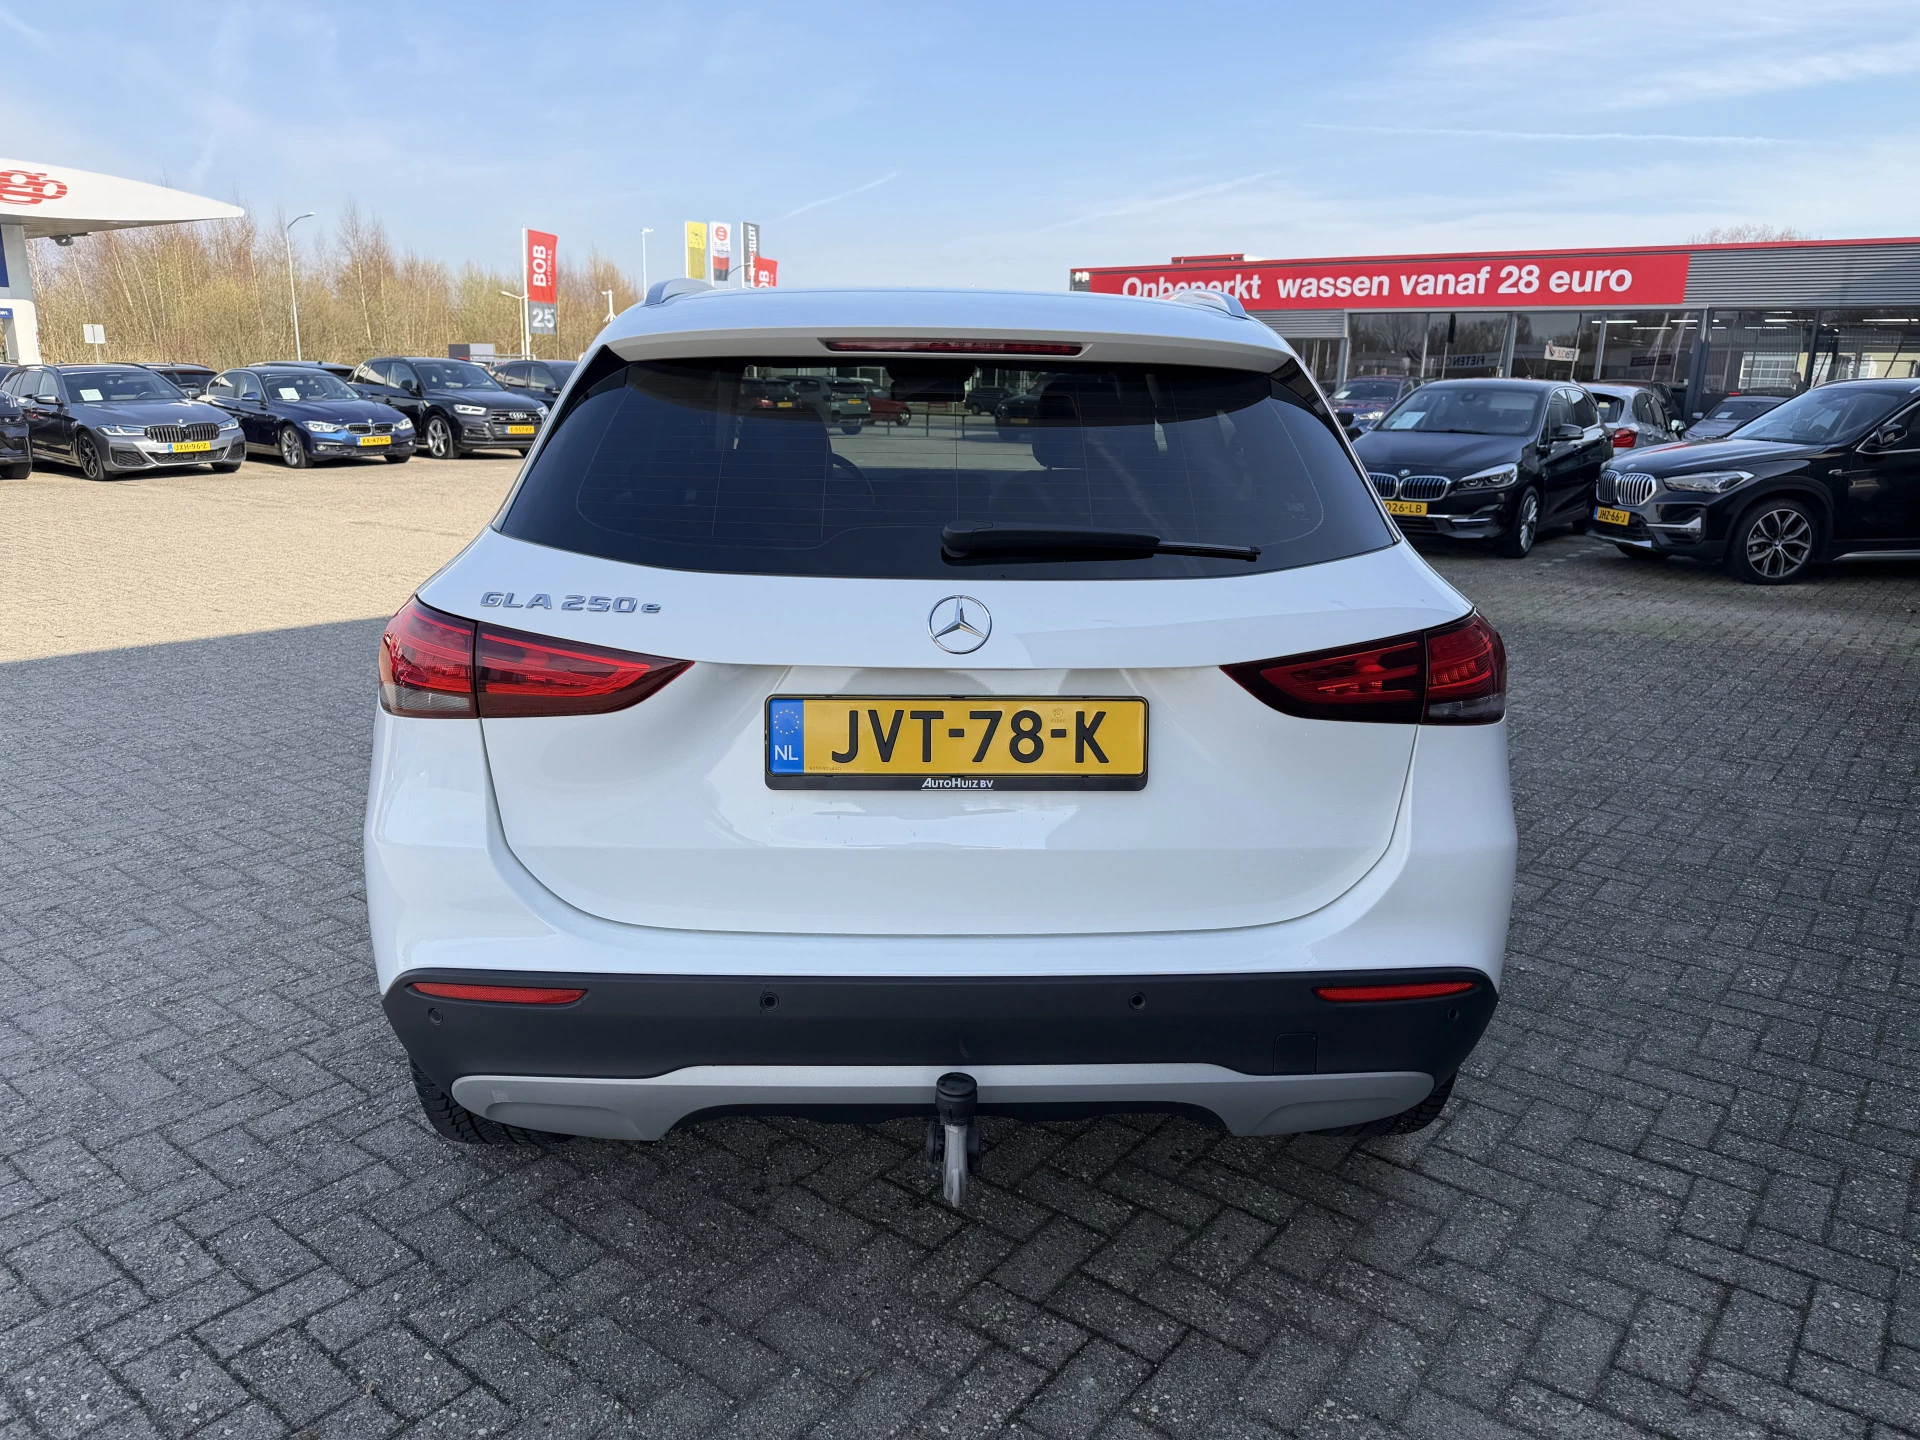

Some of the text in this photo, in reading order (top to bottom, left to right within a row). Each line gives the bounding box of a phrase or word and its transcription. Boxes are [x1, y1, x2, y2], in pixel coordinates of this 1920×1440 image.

[532, 244, 547, 287] BOB
[758, 270, 770, 288] OB
[1277, 275, 1390, 299] wassen
[1400, 265, 1491, 296] vanaf
[1497, 264, 1540, 294] 28
[1549, 269, 1633, 293] euro
[532, 307, 555, 328] 25
[1385, 502, 1422, 513] 026-LB
[1598, 509, 1626, 523] JHZ-66-J
[480, 591, 661, 613] GLA 250 e
[774, 709, 1110, 764] NL JVT-78-K
[980, 779, 994, 788] BV
